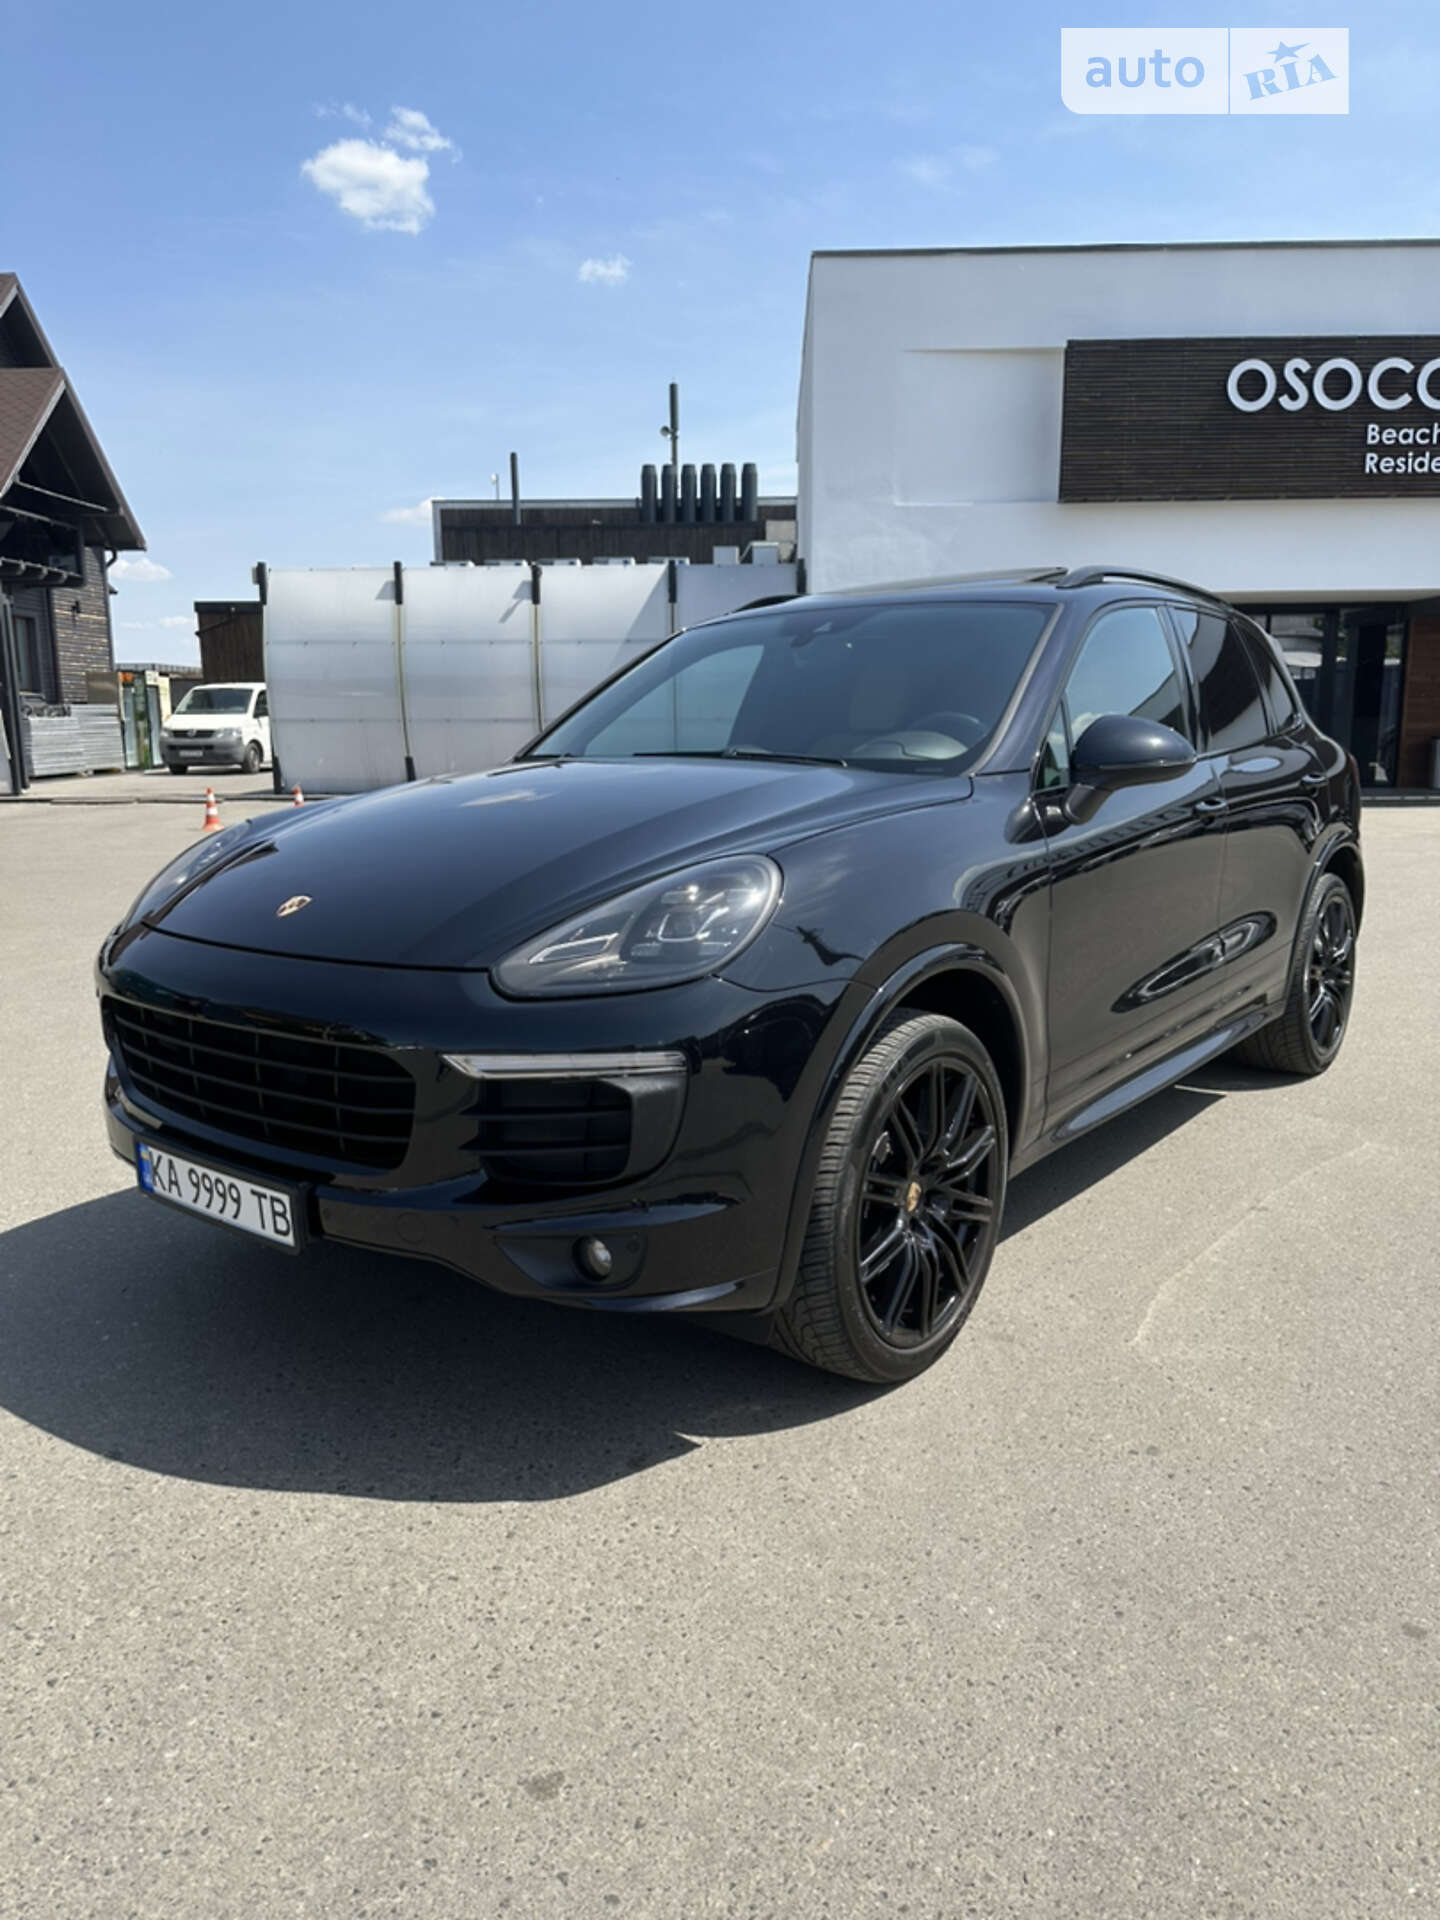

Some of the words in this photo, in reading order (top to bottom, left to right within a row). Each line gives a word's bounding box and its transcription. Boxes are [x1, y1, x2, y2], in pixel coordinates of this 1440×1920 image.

[150, 1151, 182, 1198] KA
[188, 1167, 241, 1221] 9999
[250, 1188, 292, 1238] TB
